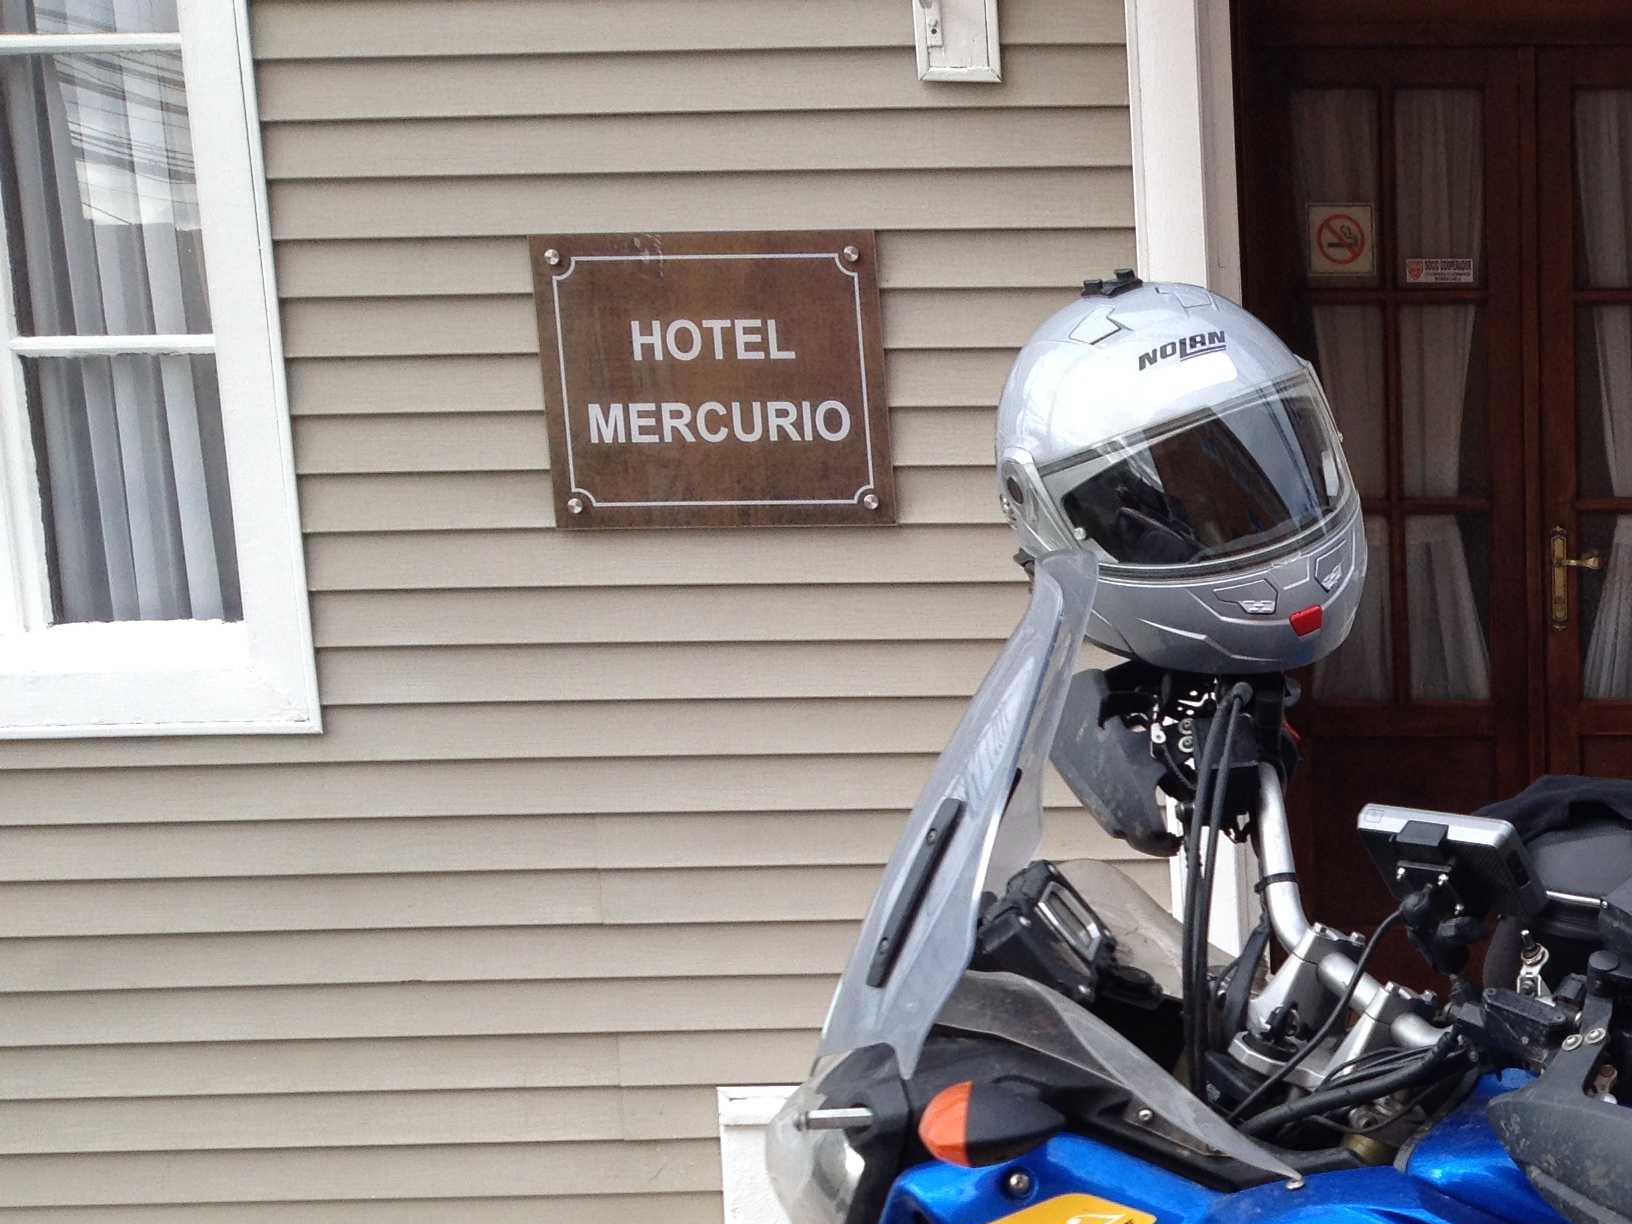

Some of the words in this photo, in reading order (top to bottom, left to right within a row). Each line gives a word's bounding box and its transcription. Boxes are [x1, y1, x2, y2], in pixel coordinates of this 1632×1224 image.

[631, 319, 796, 361] HOTEL
[1138, 330, 1227, 371] NOLAN
[587, 400, 851, 443] MERCURIO
